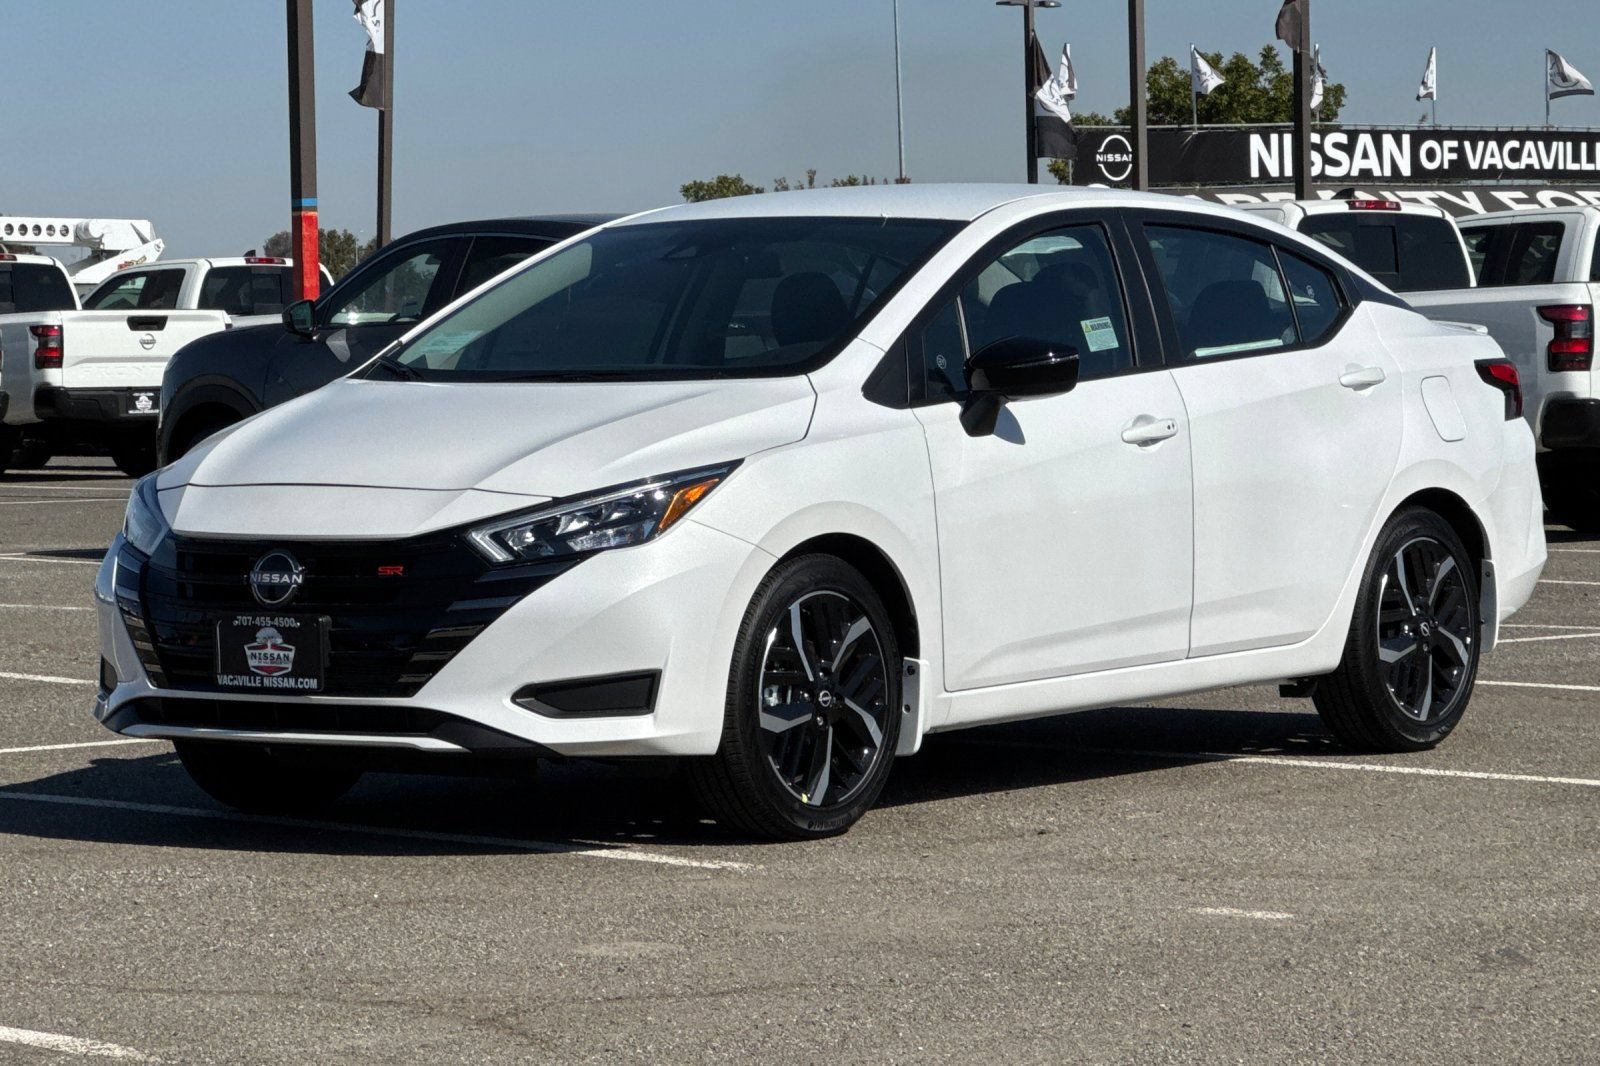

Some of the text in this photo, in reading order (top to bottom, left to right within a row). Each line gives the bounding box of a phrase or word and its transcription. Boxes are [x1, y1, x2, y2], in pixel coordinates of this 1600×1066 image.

[1419, 140, 1458, 170] OF
[378, 566, 404, 576] SR
[250, 572, 303, 584] NISSAN
[236, 616, 296, 627] 707-455-4500
[250, 652, 290, 661] NISSAN
[217, 674, 318, 689] VACAVILLE NISSAN.COM
